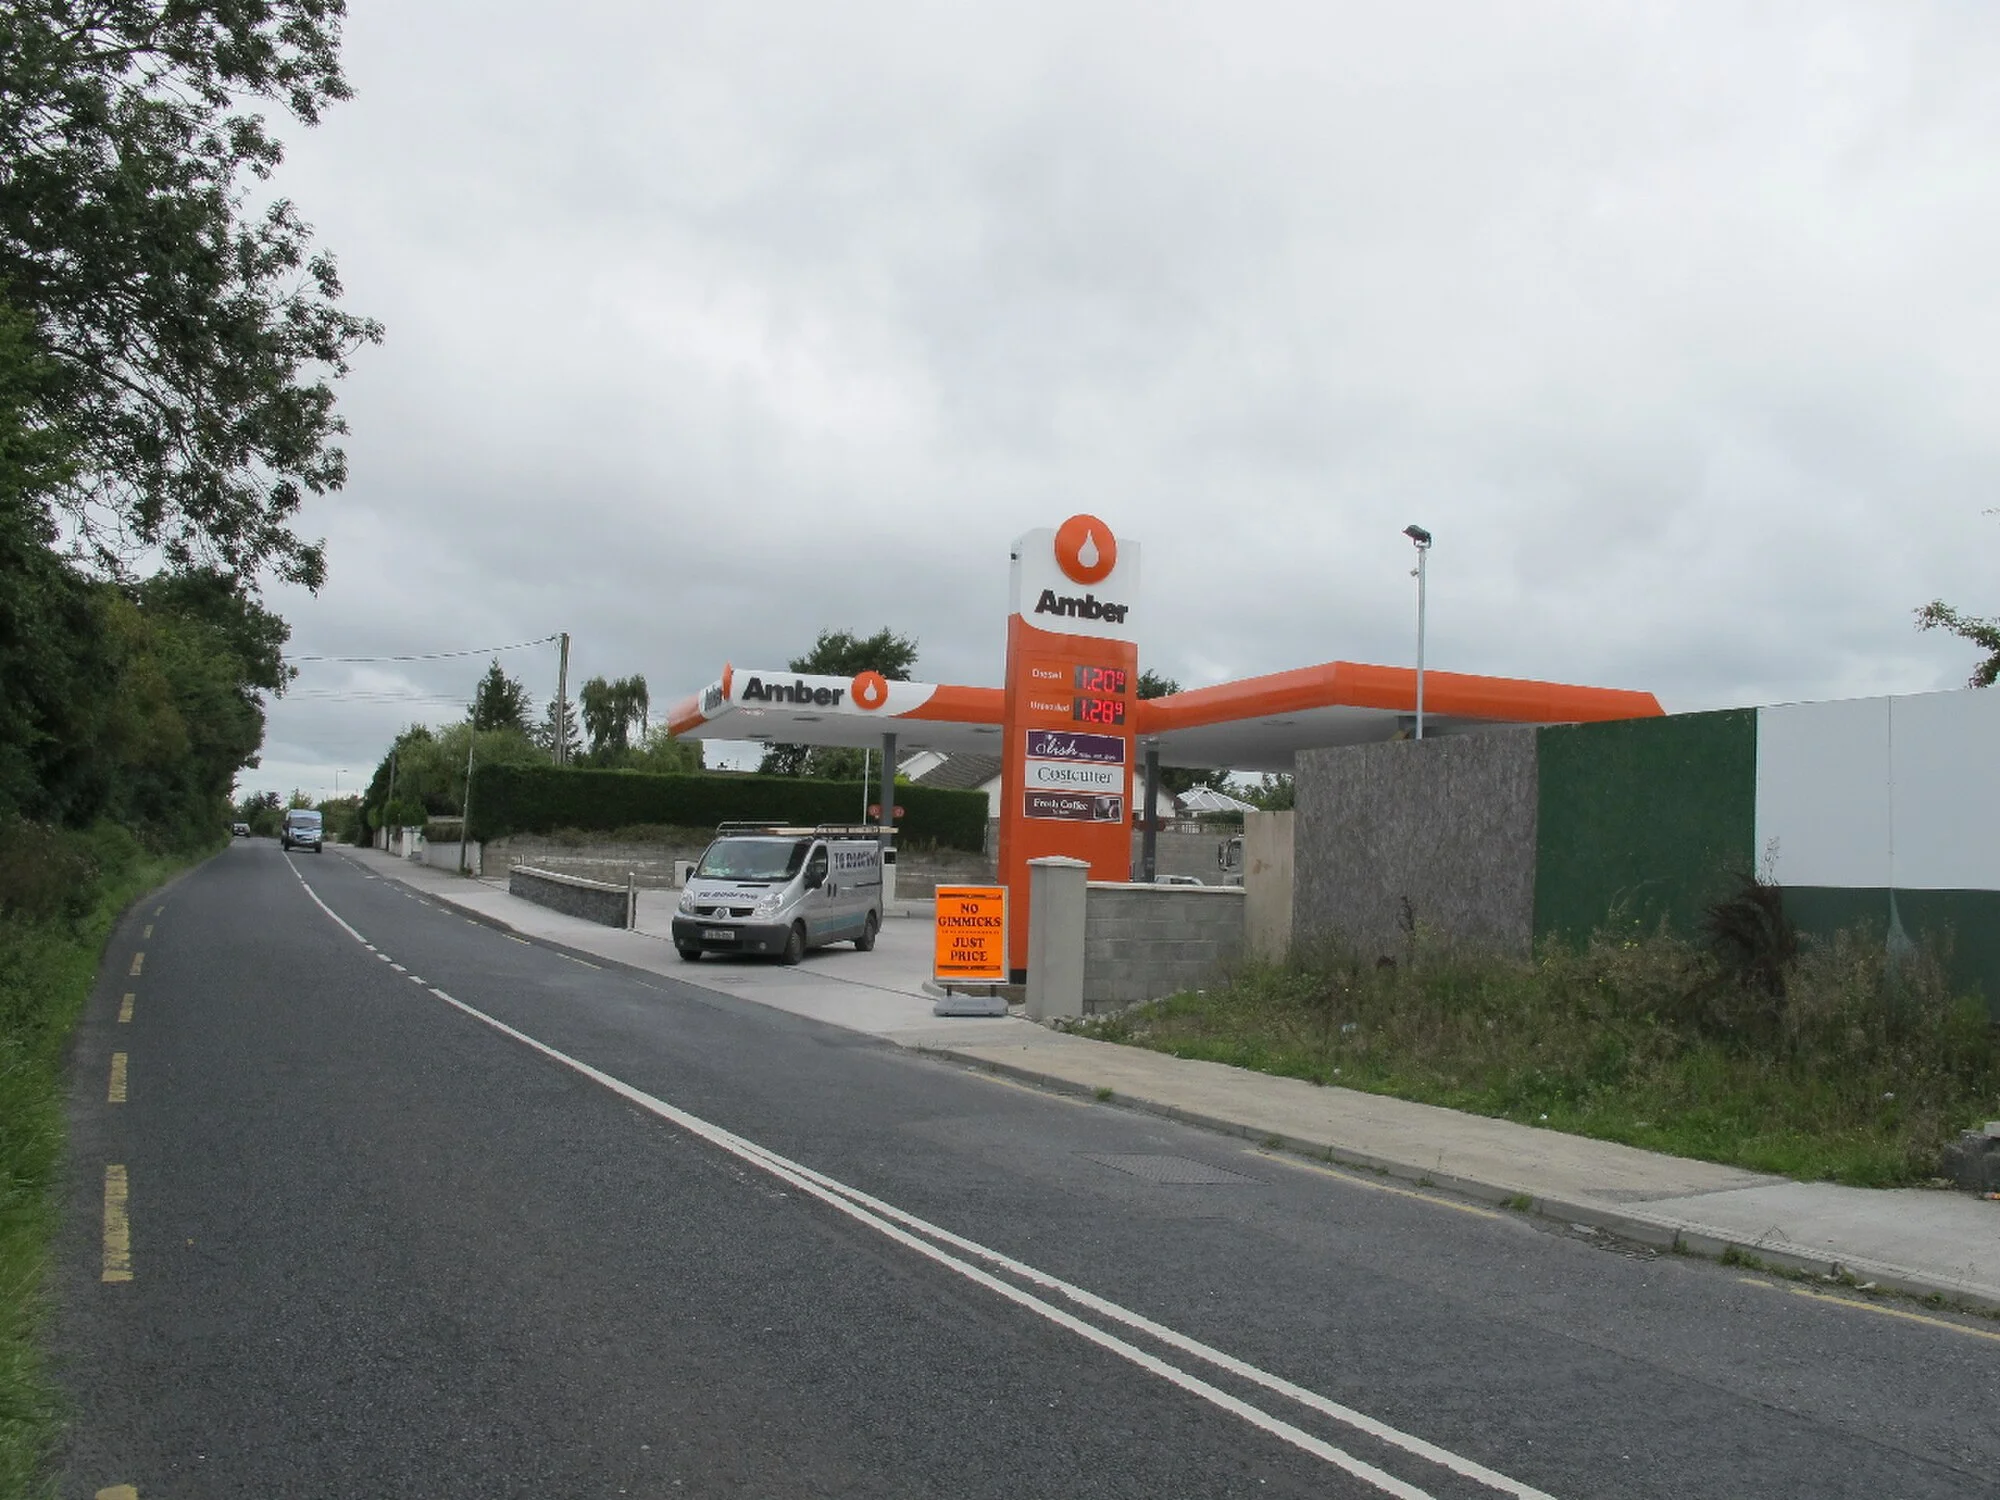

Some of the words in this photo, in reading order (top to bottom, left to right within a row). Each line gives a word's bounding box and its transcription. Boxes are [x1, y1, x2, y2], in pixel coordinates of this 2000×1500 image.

[1034, 589, 1129, 624] Amber
[741, 677, 846, 706] Amber
[1037, 766, 1113, 784] Costcutter
[960, 903, 979, 914] NO
[938, 916, 1002, 927] GIMMICKS
[952, 937, 985, 948] JUST
[950, 951, 988, 962] PRICE
